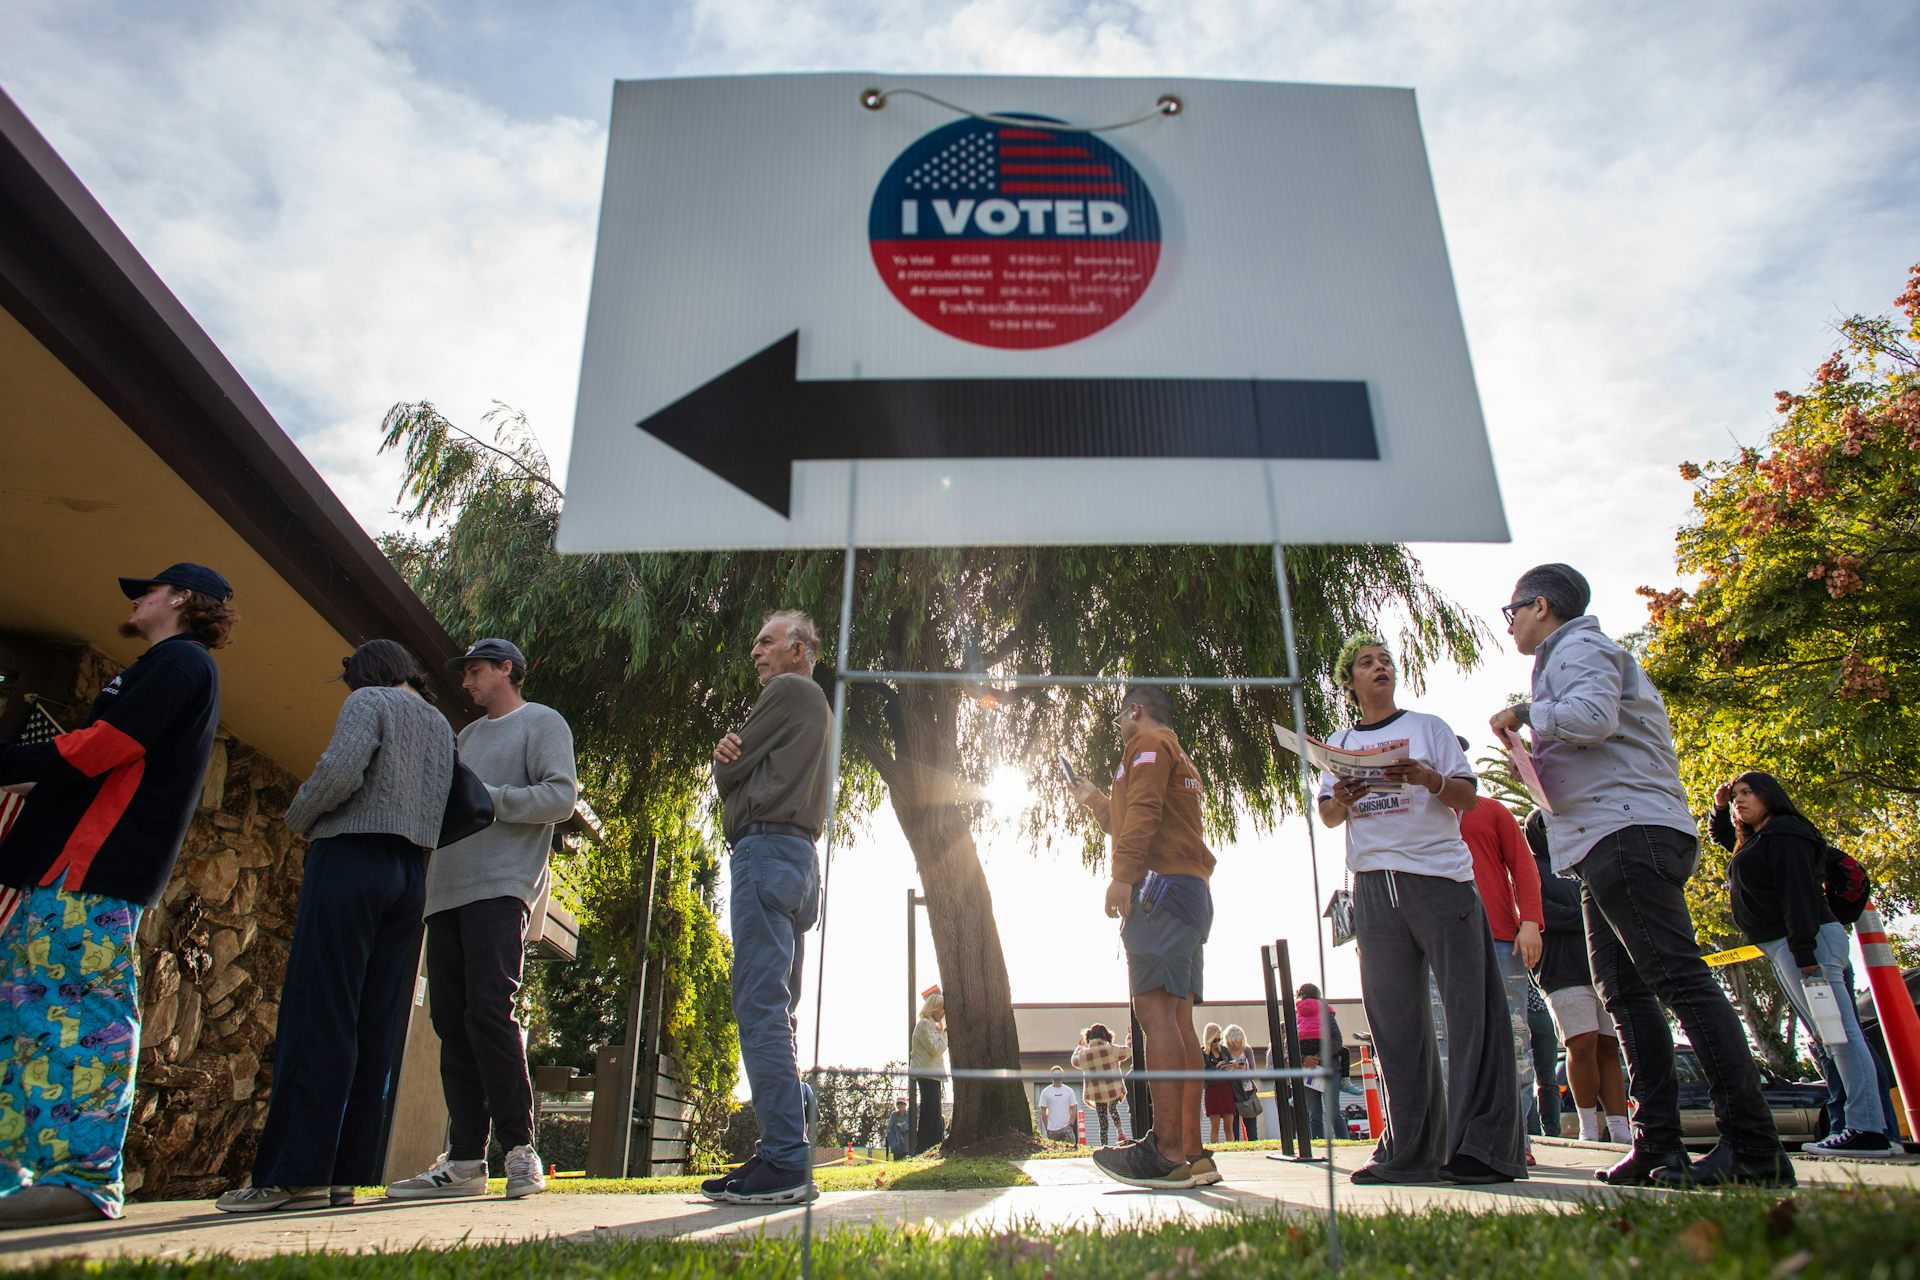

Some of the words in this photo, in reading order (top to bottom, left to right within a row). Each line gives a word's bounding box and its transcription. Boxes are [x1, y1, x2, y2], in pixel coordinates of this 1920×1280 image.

[902, 199, 918, 235] I
[931, 198, 1129, 236] VOTED
[1359, 797, 1399, 812] CHISHOLM
